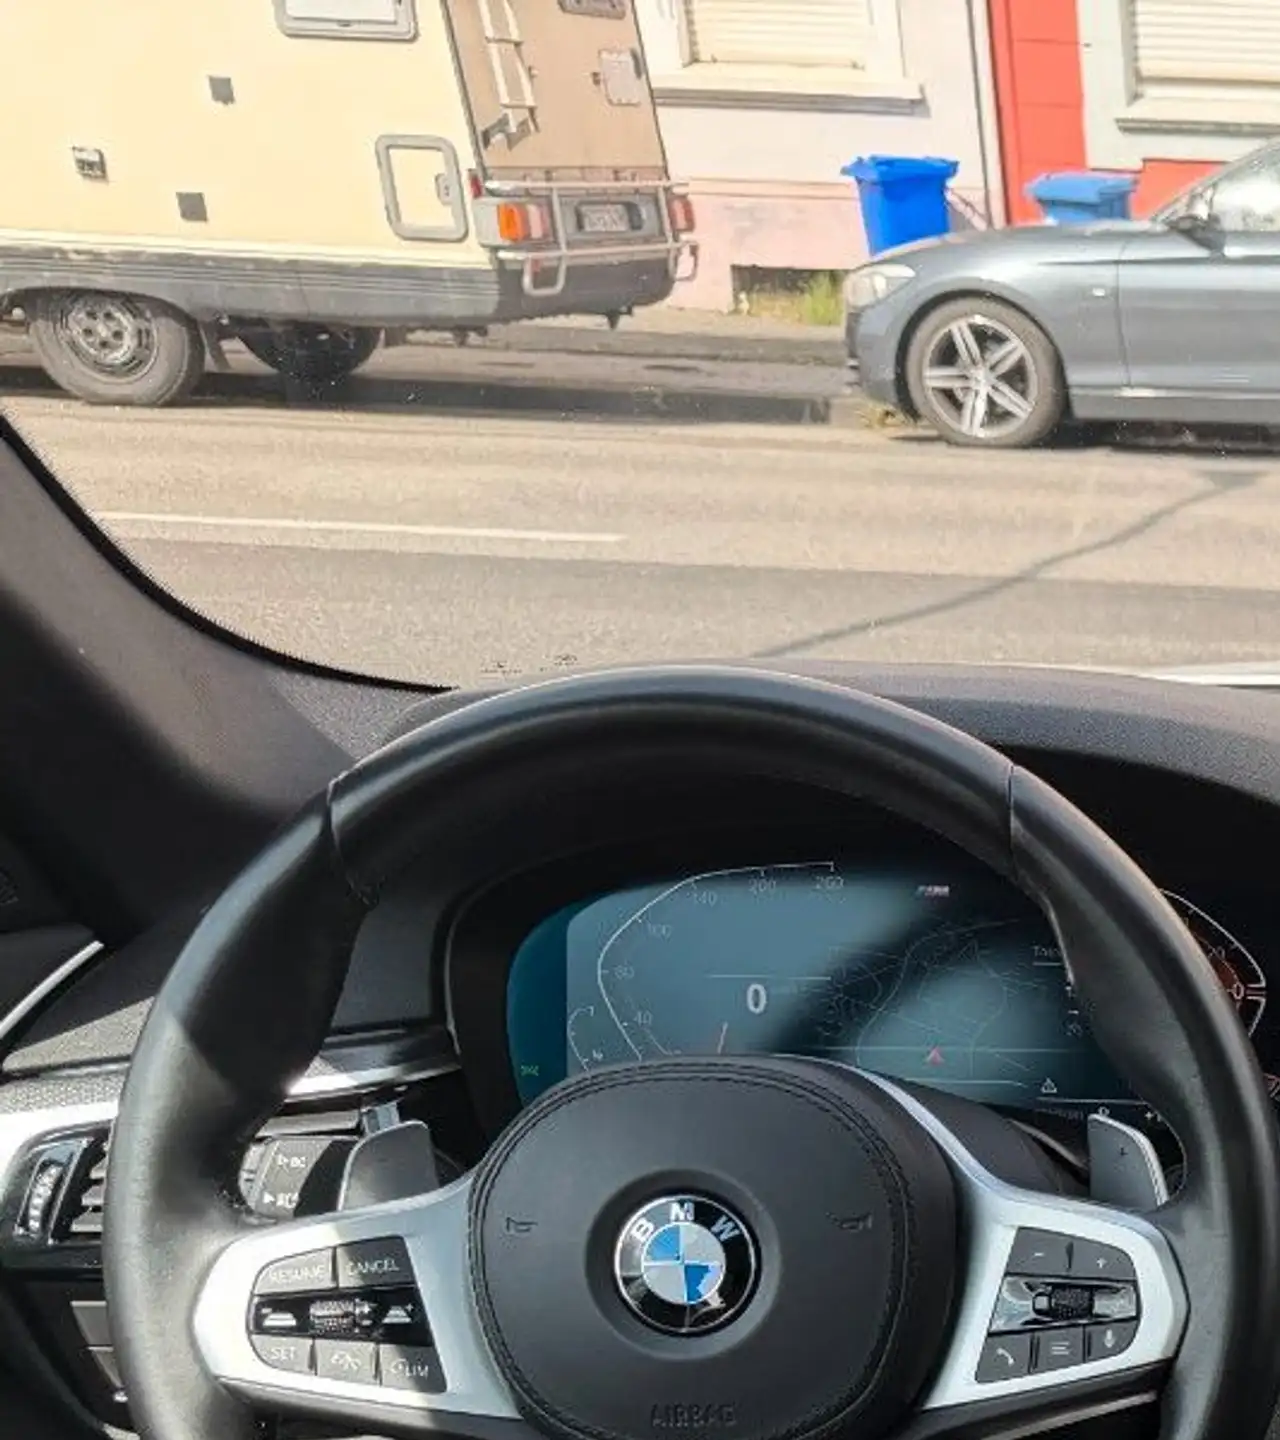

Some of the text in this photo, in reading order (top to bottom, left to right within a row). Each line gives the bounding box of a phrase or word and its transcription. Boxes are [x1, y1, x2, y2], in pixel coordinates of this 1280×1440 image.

[746, 983, 768, 1014] 0
[630, 1202, 742, 1242] BMW
[270, 1258, 400, 1284] RESUME CANCEL
[270, 1347, 296, 1361] SET
